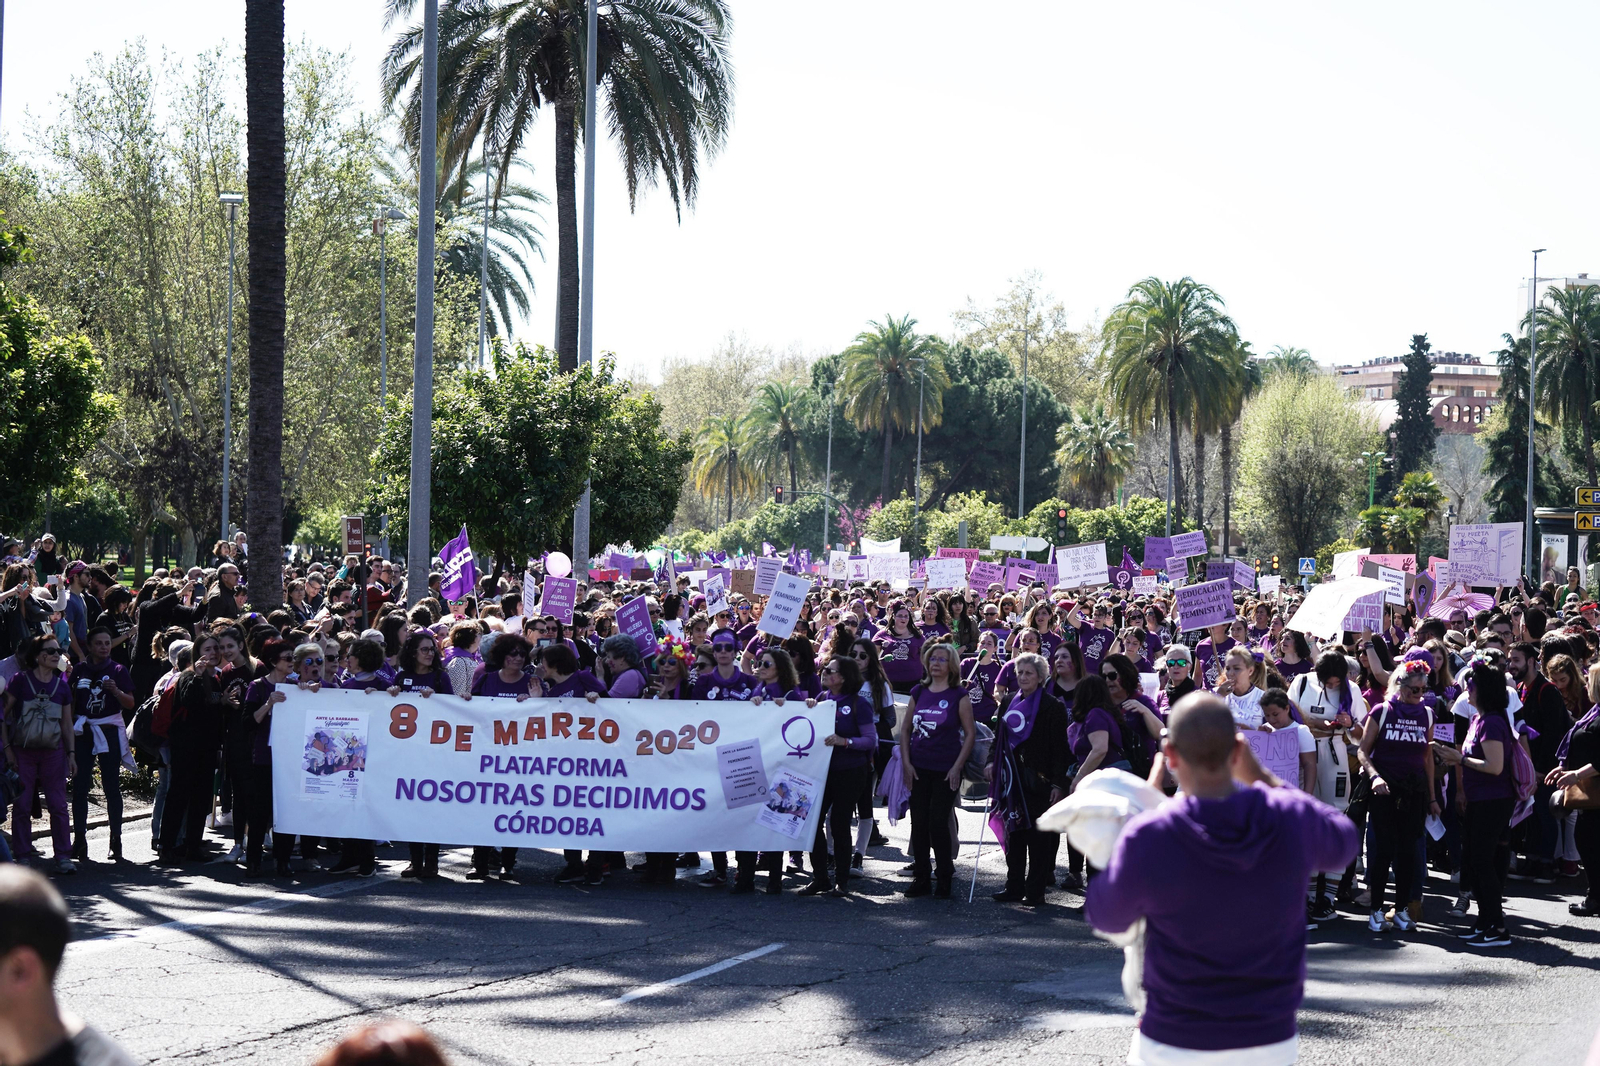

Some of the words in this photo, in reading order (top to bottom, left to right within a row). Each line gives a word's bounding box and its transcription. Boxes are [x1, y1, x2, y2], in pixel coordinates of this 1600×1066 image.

[1064, 550, 1071, 558] NO
[1084, 544, 1100, 554] MUJER
[774, 591, 802, 603] FEMINISMO
[769, 614, 789, 624] FUTURO
[389, 703, 418, 739] 8
[430, 720, 474, 751] DE
[493, 712, 620, 746] MARZO
[635, 720, 720, 755] 2020
[1385, 730, 1427, 743] MATA
[1266, 731, 1298, 760] NO
[480, 754, 628, 777] PLATAFORMA
[395, 778, 544, 806] NOSOTRAS
[553, 784, 706, 810] DECIDIMOS
[494, 810, 604, 836] CÓRDOBA
